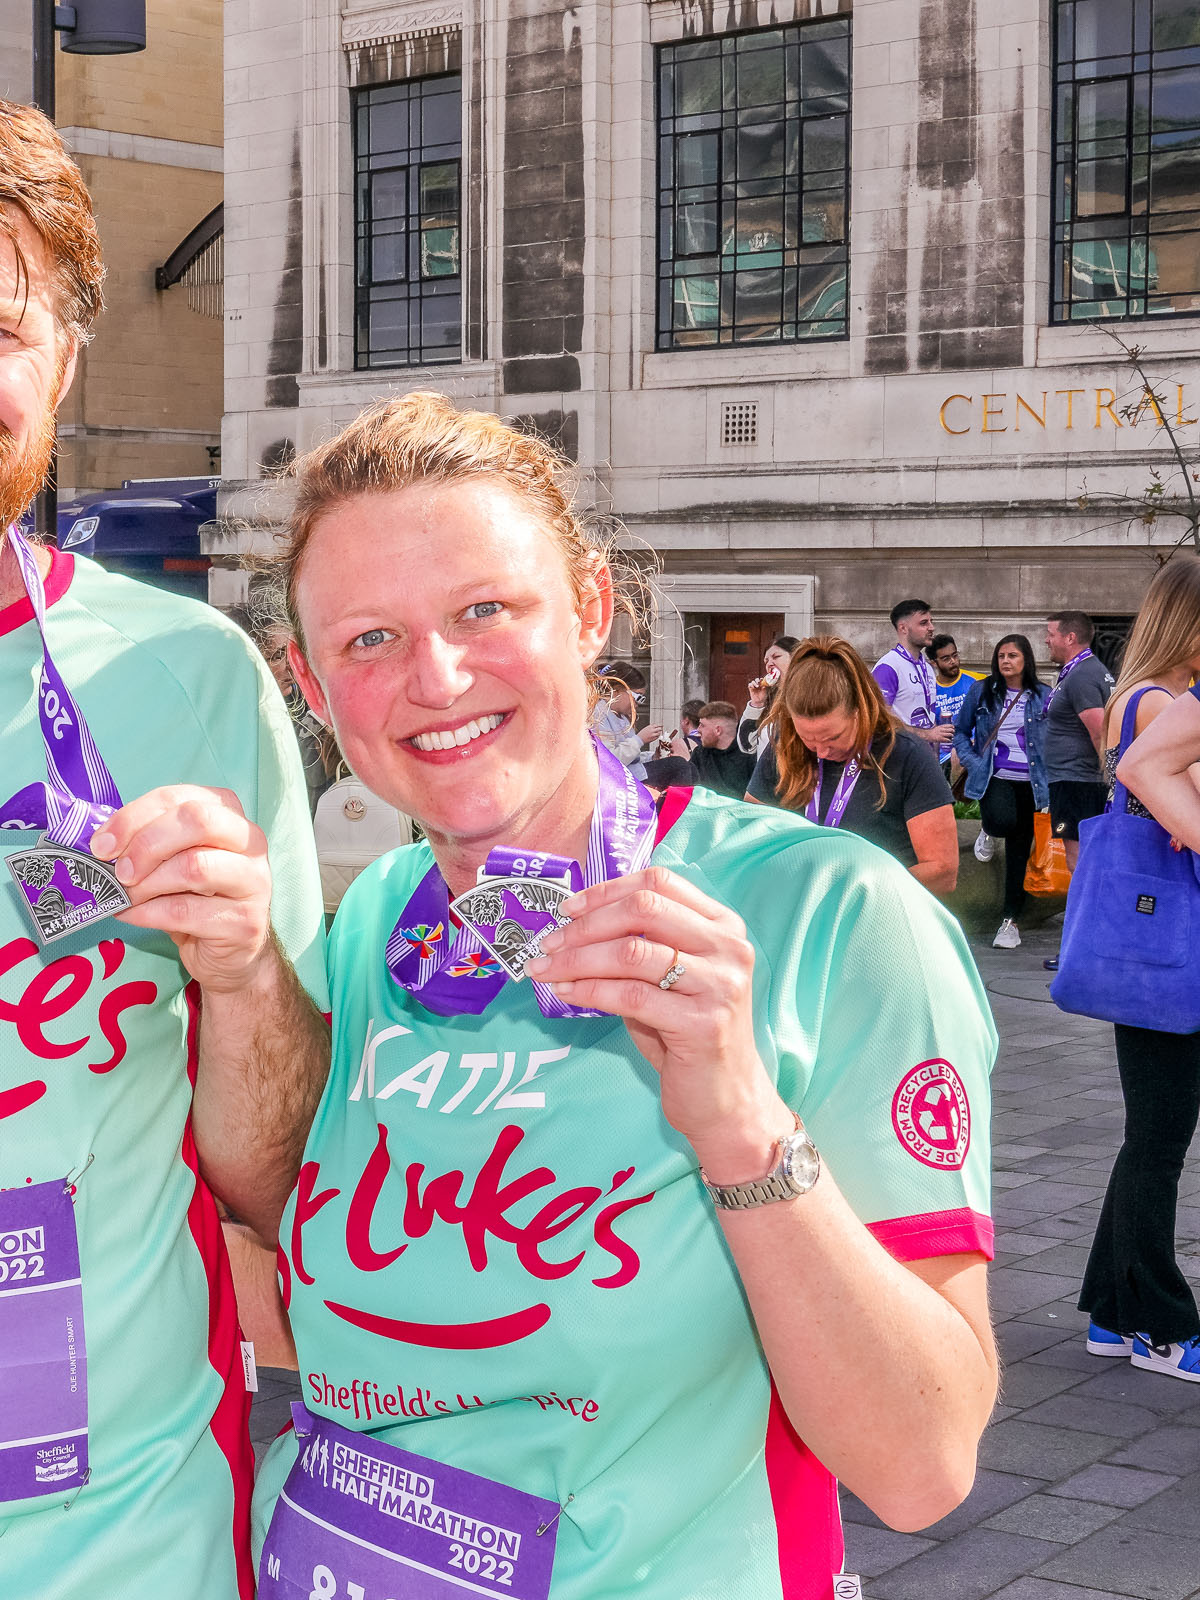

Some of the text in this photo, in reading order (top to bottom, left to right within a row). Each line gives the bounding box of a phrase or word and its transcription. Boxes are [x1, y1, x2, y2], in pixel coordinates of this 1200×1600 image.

[939, 384, 1199, 435] CENTRAL
[61, 903, 93, 922] SHEFFIELD
[64, 898, 121, 928] HALF MARATHON
[348, 1018, 572, 1115] KATIE
[898, 1066, 950, 1114] RECYCLED
[951, 1078, 968, 1144] BOTTLES
[899, 1119, 932, 1157] FROM
[345, 1123, 657, 1290] Luke's
[66, 1316, 78, 1393] OLIE HUNTER SMART
[308, 1372, 453, 1420] Sheffield's
[36, 1443, 75, 1460] Sheffield
[53, 1453, 71, 1462] Council
[334, 1445, 431, 1499] SHEFFIELD
[332, 1470, 518, 1556] HALF MARATHON
[267, 1553, 281, 1581] M
[448, 1543, 515, 1586] 2022
